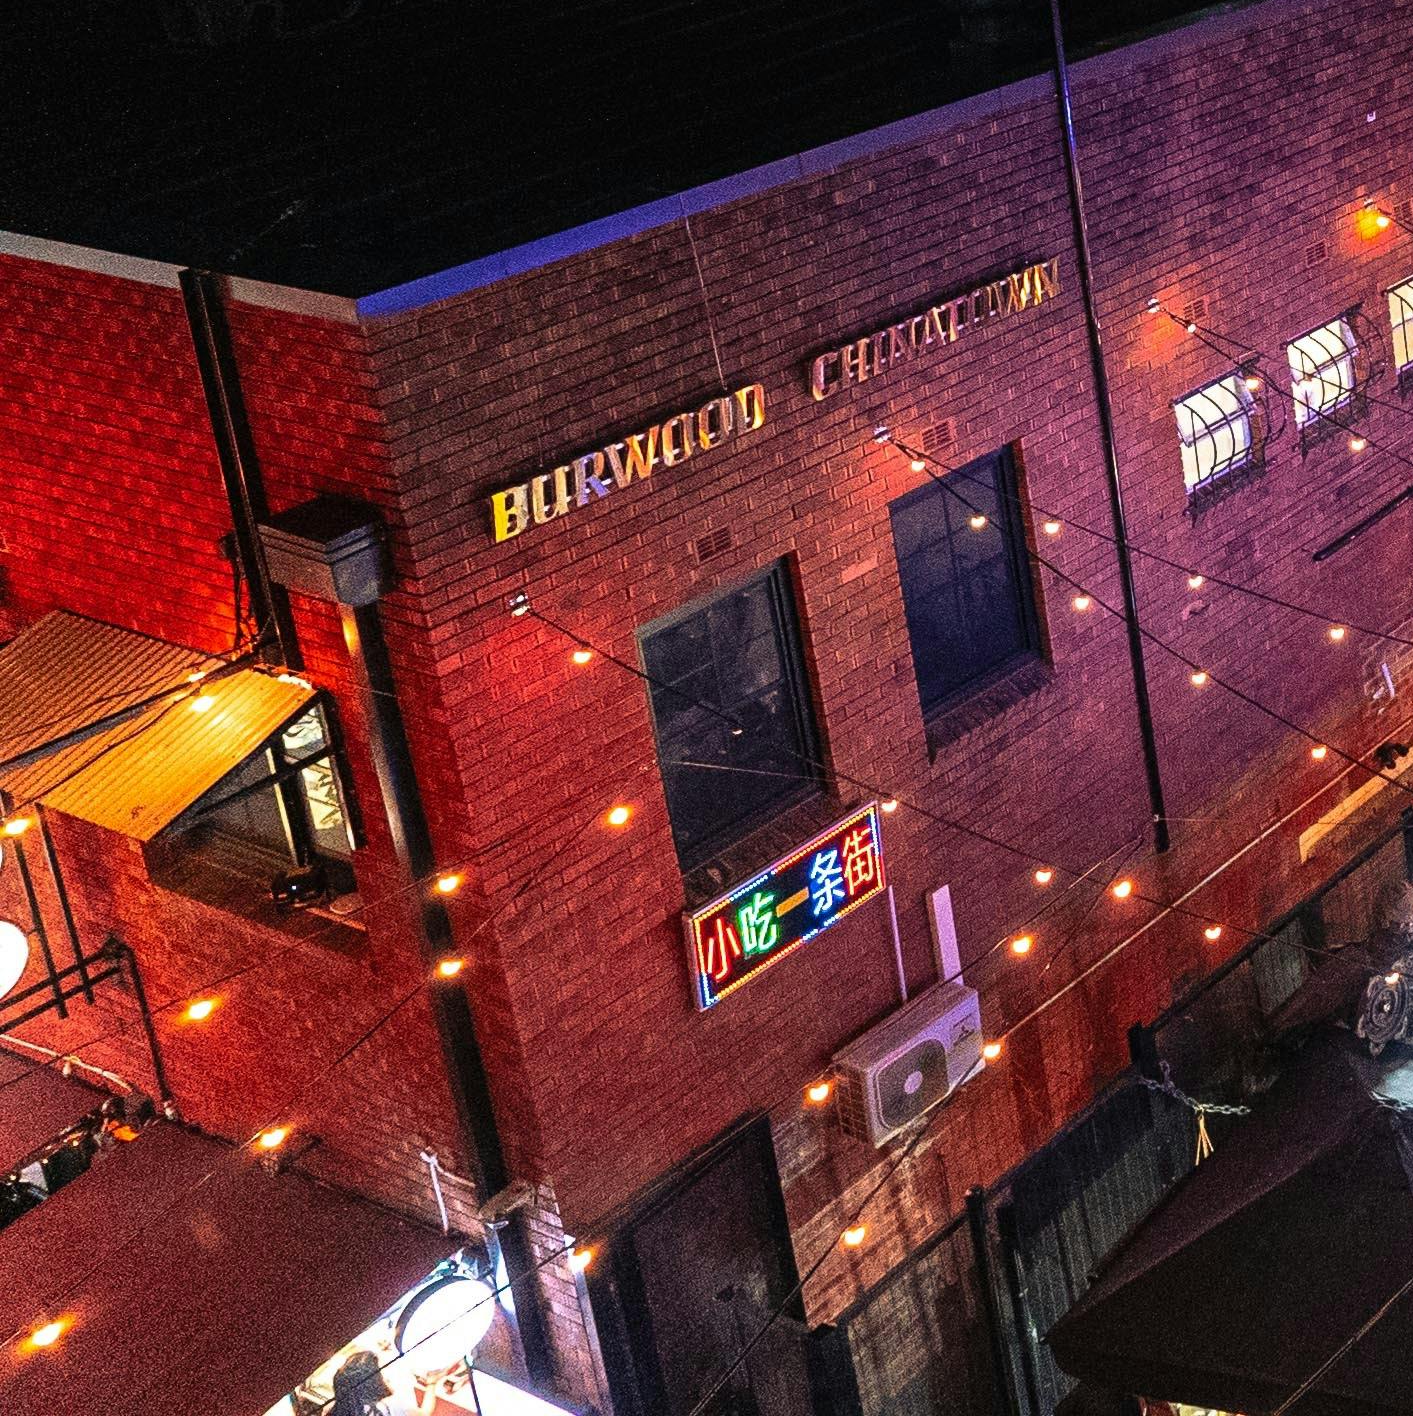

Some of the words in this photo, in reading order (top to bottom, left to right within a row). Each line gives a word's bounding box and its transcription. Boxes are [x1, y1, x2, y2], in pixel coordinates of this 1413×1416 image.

[491, 382, 765, 543] BURWOOD
[811, 256, 1062, 402] CHINATOWN
[707, 825, 874, 980] 小吃一条街
